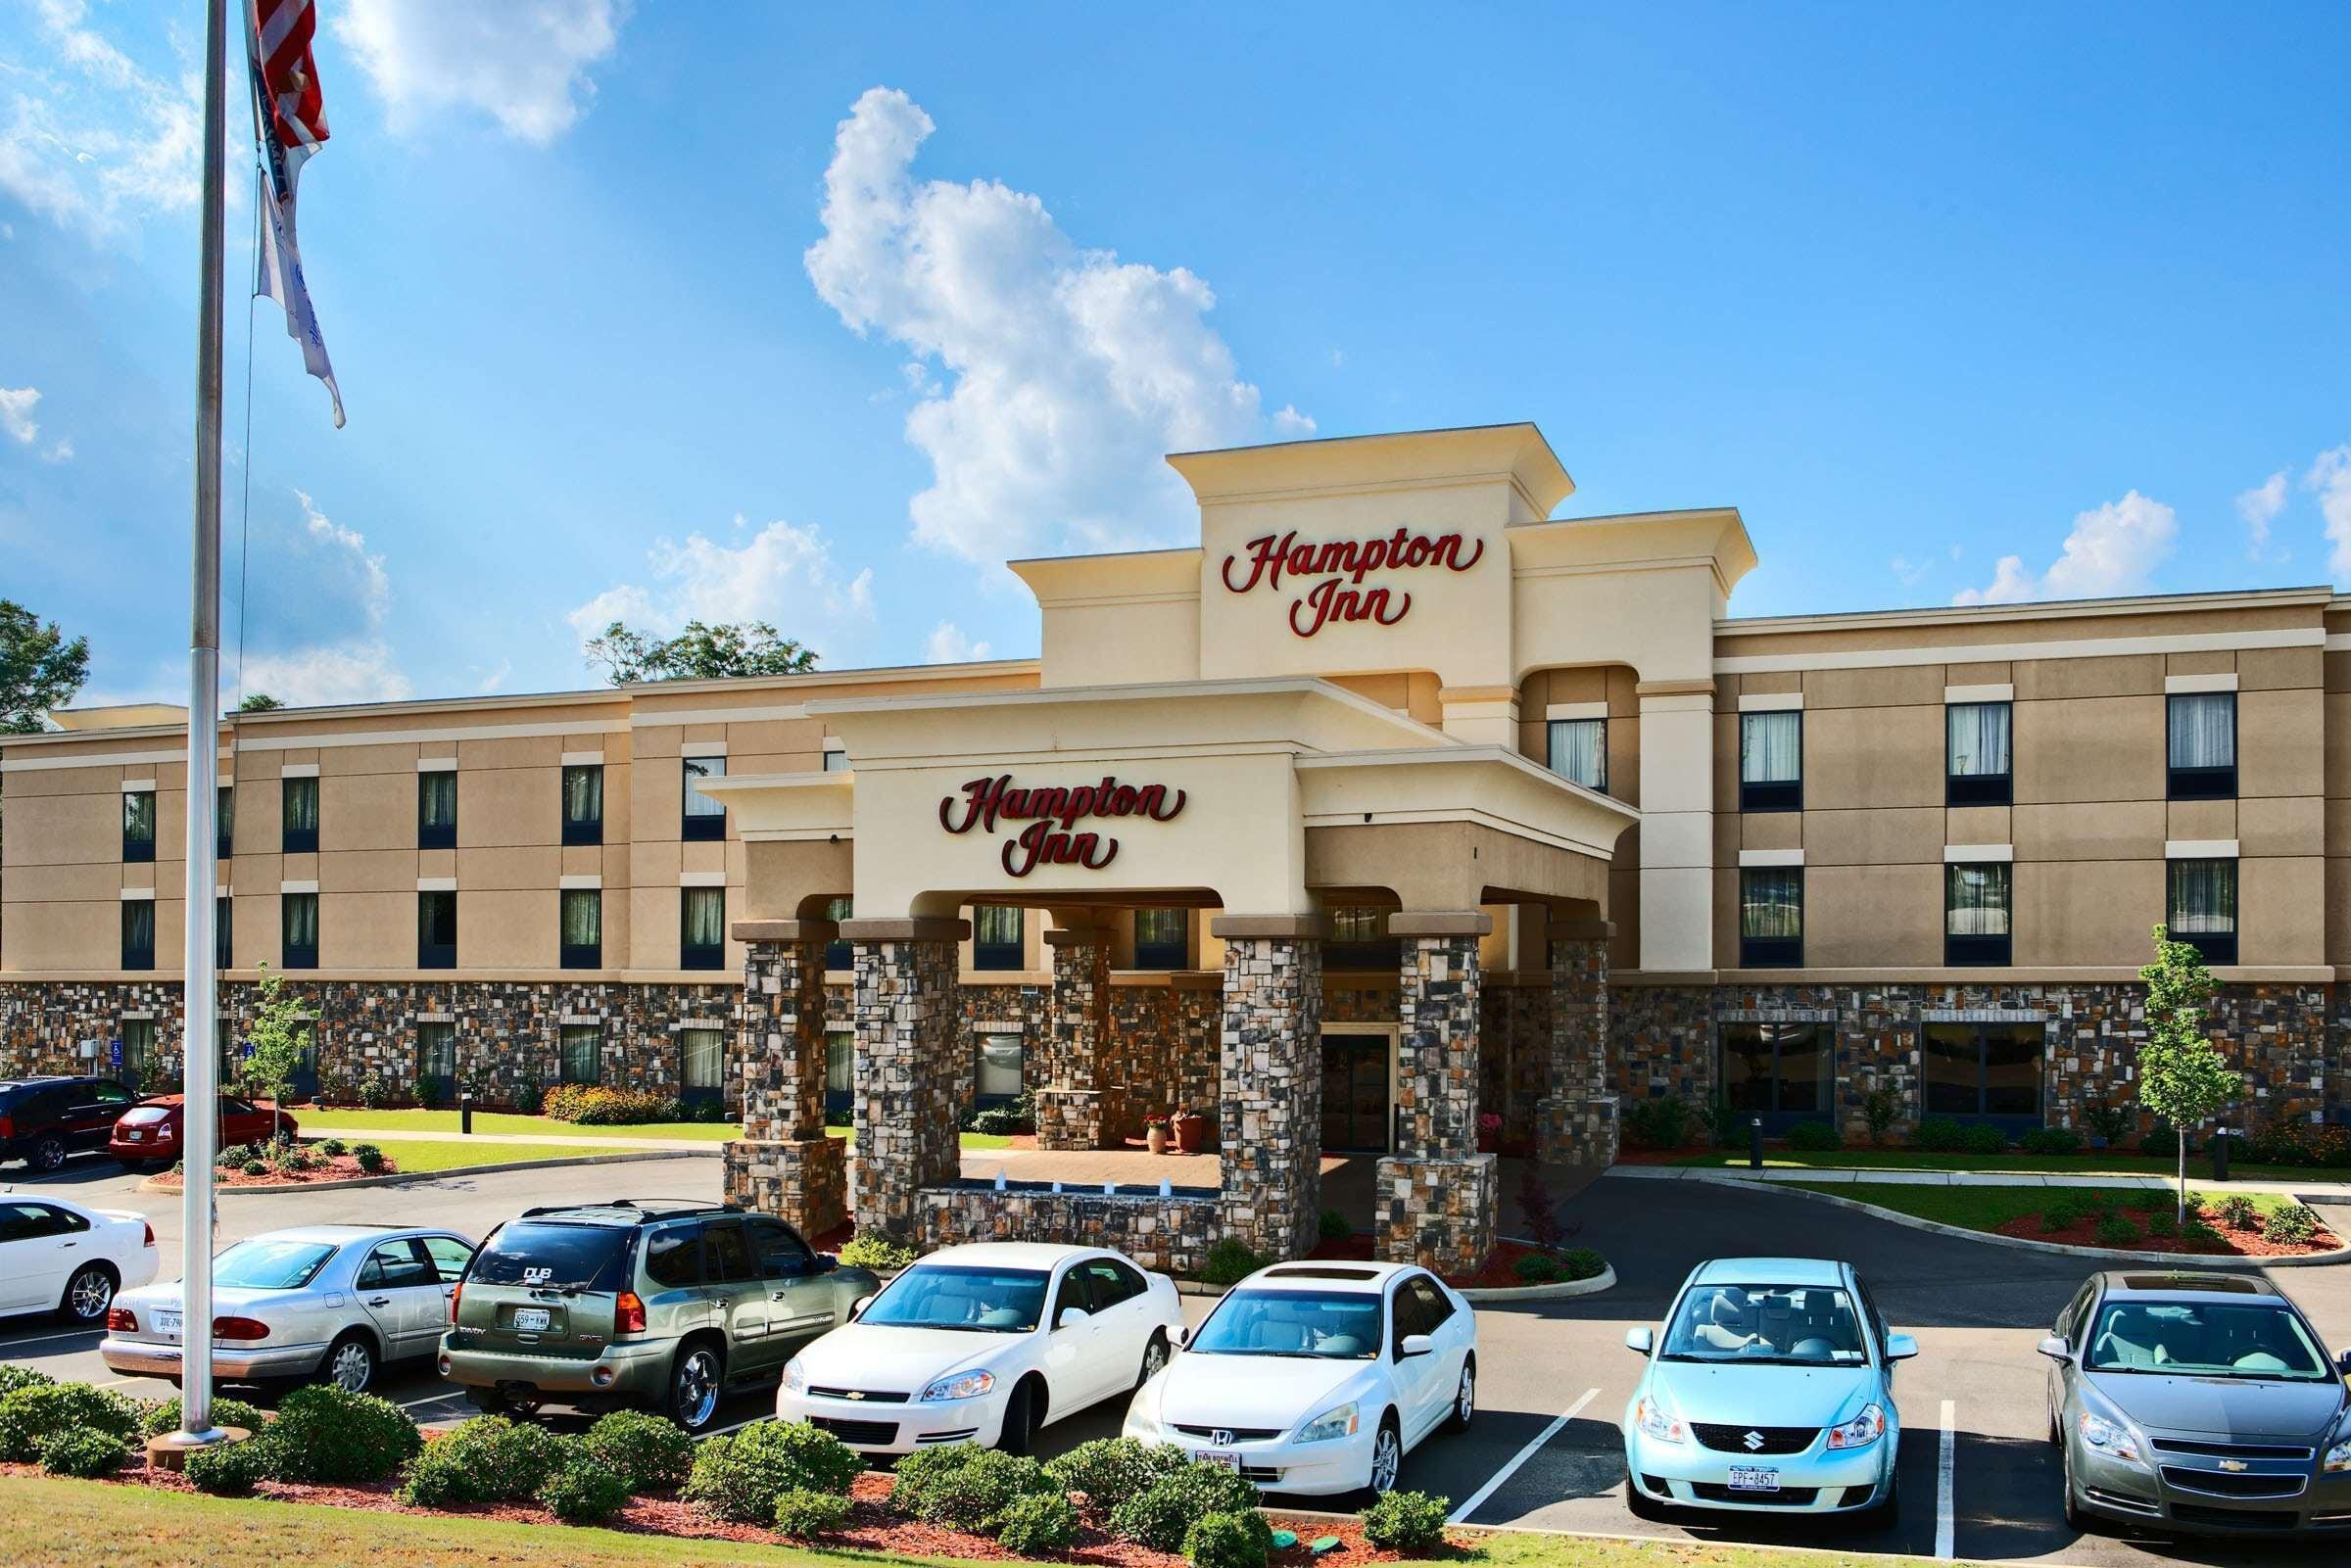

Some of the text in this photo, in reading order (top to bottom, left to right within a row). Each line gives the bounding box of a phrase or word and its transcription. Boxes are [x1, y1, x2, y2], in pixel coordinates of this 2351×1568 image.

[1223, 528, 1484, 594] Hampton
[1289, 578, 1412, 638] Inn
[939, 775, 1187, 833] Hampton
[1001, 820, 1120, 878] Inn
[523, 1267, 552, 1279] DUB
